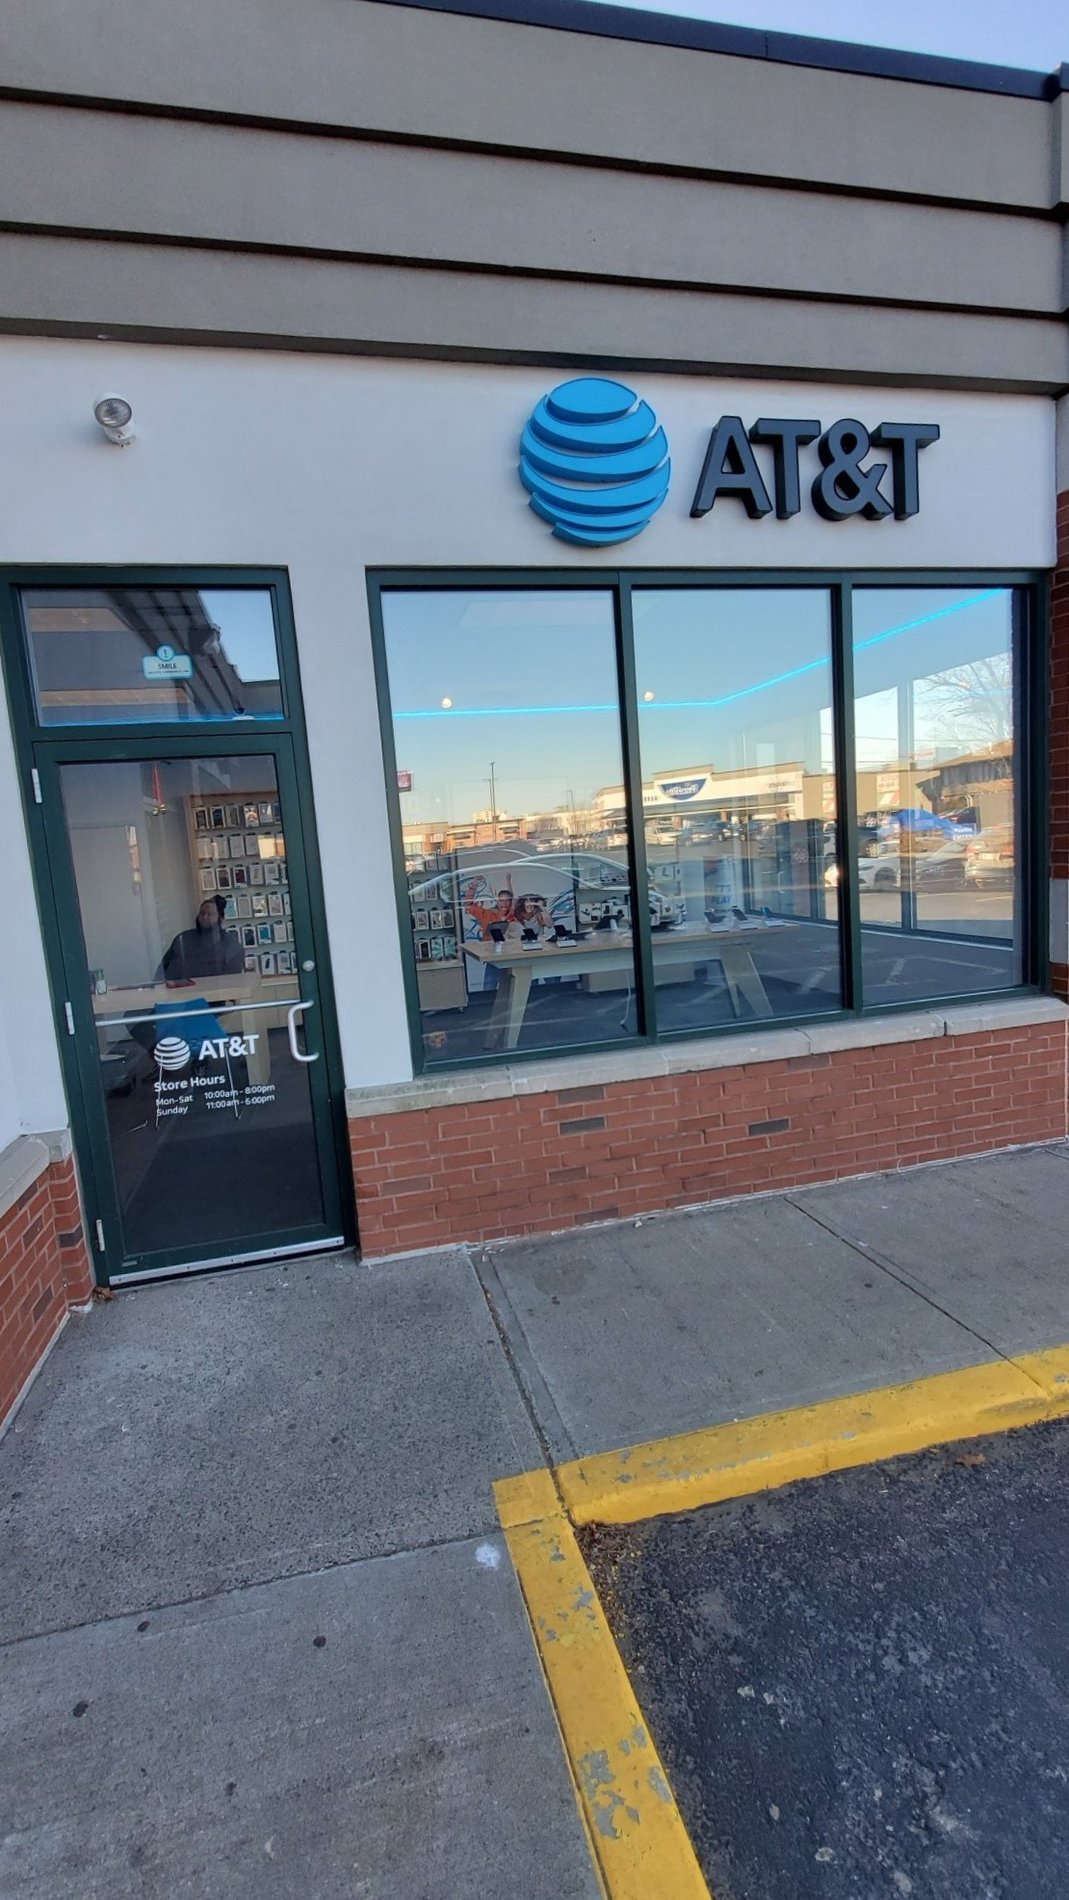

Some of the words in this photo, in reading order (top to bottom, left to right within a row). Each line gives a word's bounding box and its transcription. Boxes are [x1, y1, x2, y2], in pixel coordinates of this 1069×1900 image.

[689, 415, 941, 522] AT&T
[198, 1033, 260, 1061] AT&T
[153, 1079, 188, 1092] Store
[190, 1074, 226, 1088] Hours
[155, 1094, 194, 1107] Mon-Sat
[204, 1089, 239, 1100] 10:00am
[244, 1084, 276, 1095] 8:00pm
[156, 1105, 189, 1117] Sunday
[206, 1099, 240, 1110] 11:00am
[245, 1093, 275, 1106] 6:00pm
